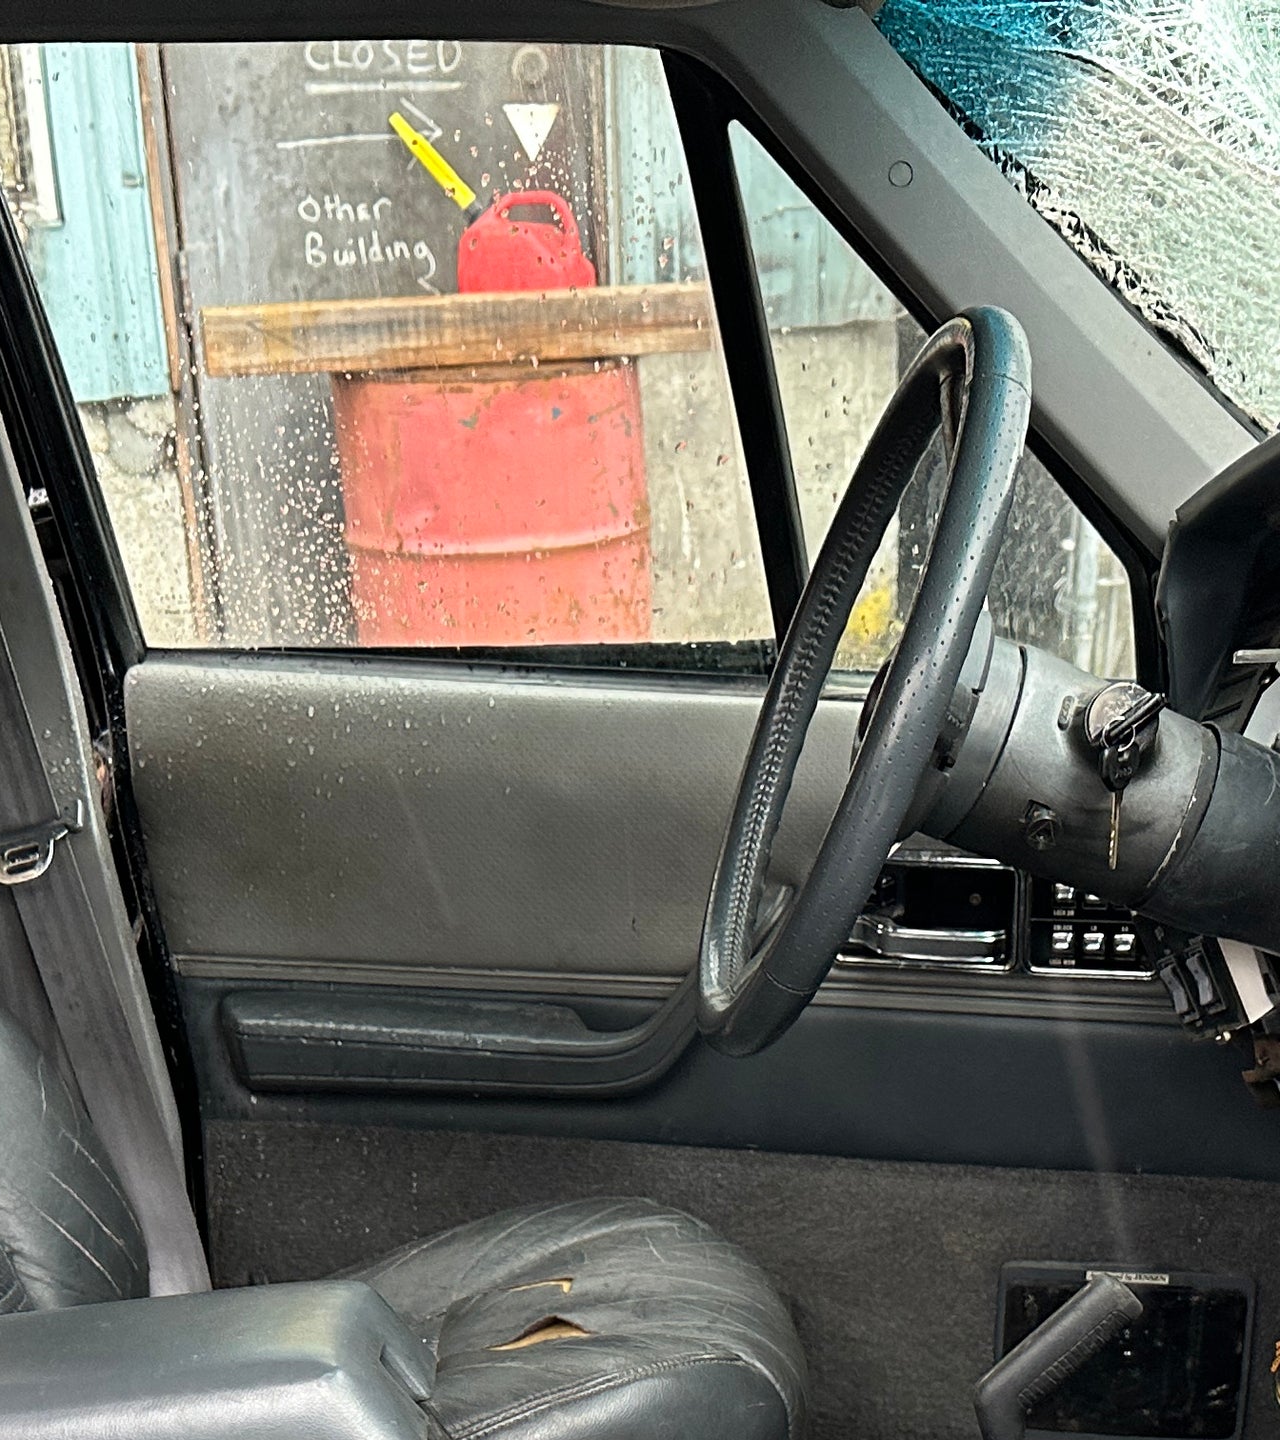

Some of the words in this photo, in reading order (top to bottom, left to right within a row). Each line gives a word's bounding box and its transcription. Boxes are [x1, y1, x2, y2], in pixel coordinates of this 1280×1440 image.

[305, 40, 462, 73] CLOSED
[298, 194, 391, 222] Other
[305, 230, 436, 280] Building
